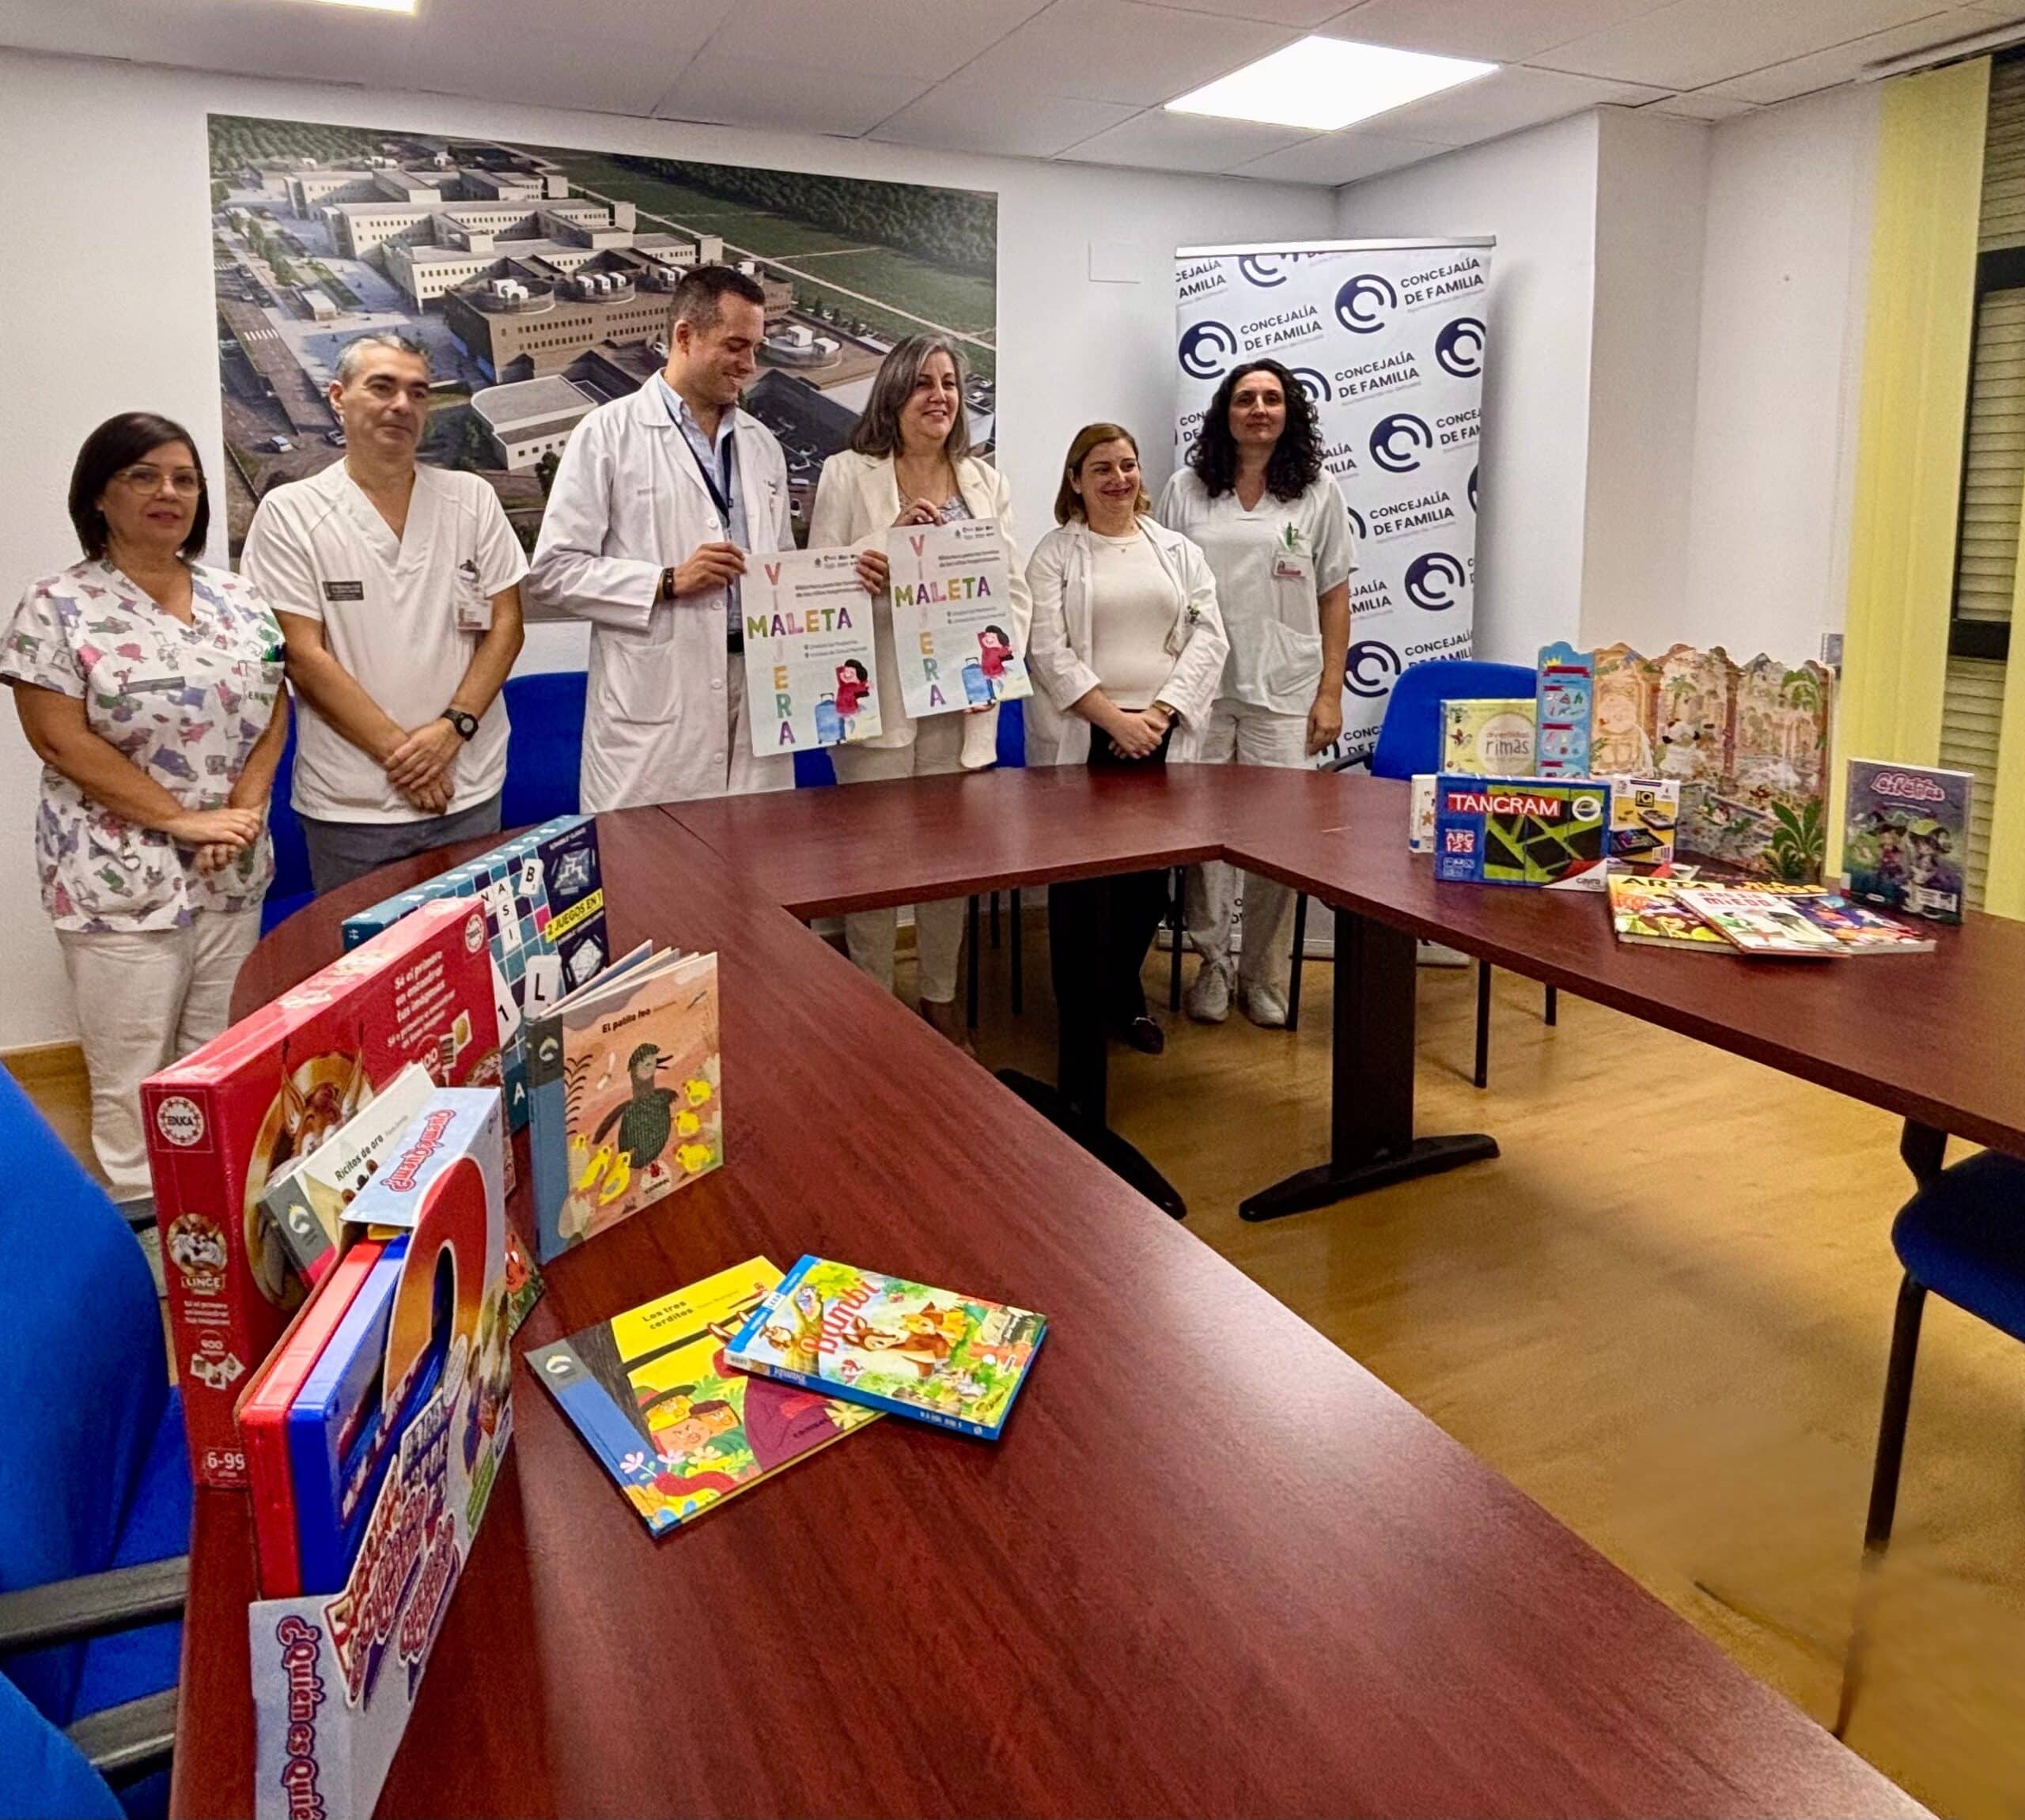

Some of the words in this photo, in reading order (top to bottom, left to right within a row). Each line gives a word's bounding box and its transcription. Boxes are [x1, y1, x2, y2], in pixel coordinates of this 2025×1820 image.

[1400, 257, 1481, 288] CONCEJALÍA
[1404, 290, 1425, 305] DE
[1426, 274, 1484, 299] FAMILIA
[1240, 305, 1318, 335] CONCEJALÍA
[1244, 339, 1262, 351] DE
[1265, 320, 1323, 346] FAMILIA
[1334, 351, 1415, 381] CONCEJALÍA
[1338, 384, 1358, 398] DE
[1361, 367, 1420, 392] FAMILIA
[1440, 430, 1459, 445] DE
[1370, 490, 1450, 520] CONCEJALÍA
[1373, 521, 1393, 536] DE
[1395, 507, 1455, 530] FAMILIA
[894, 576, 991, 608] MALETA
[1349, 579, 1387, 597] JALÍA
[747, 607, 852, 640] MALETA
[1486, 739, 1530, 755] rimas
[1448, 794, 1560, 816] TANGRAM
[1446, 833, 1474, 842] ABC
[1447, 842, 1474, 853] 123
[525, 866, 536, 883] B
[555, 903, 585, 932] JUEGOS
[587, 895, 597, 910] EN
[534, 972, 545, 1001] L
[498, 1004, 509, 1023] 1
[602, 1023, 611, 1034] El
[513, 1081, 525, 1106] A
[335, 1154, 361, 1182] Ricitos
[361, 1145, 372, 1159] de
[371, 1134, 384, 1149] oro
[642, 1310, 663, 1322] Los
[663, 1300, 687, 1313] tres
[649, 1307, 695, 1330] cerditos
[207, 1451, 245, 1470] 6-99
[277, 1615, 326, 1723] ¿Quién
[286, 1723, 315, 1757] es
